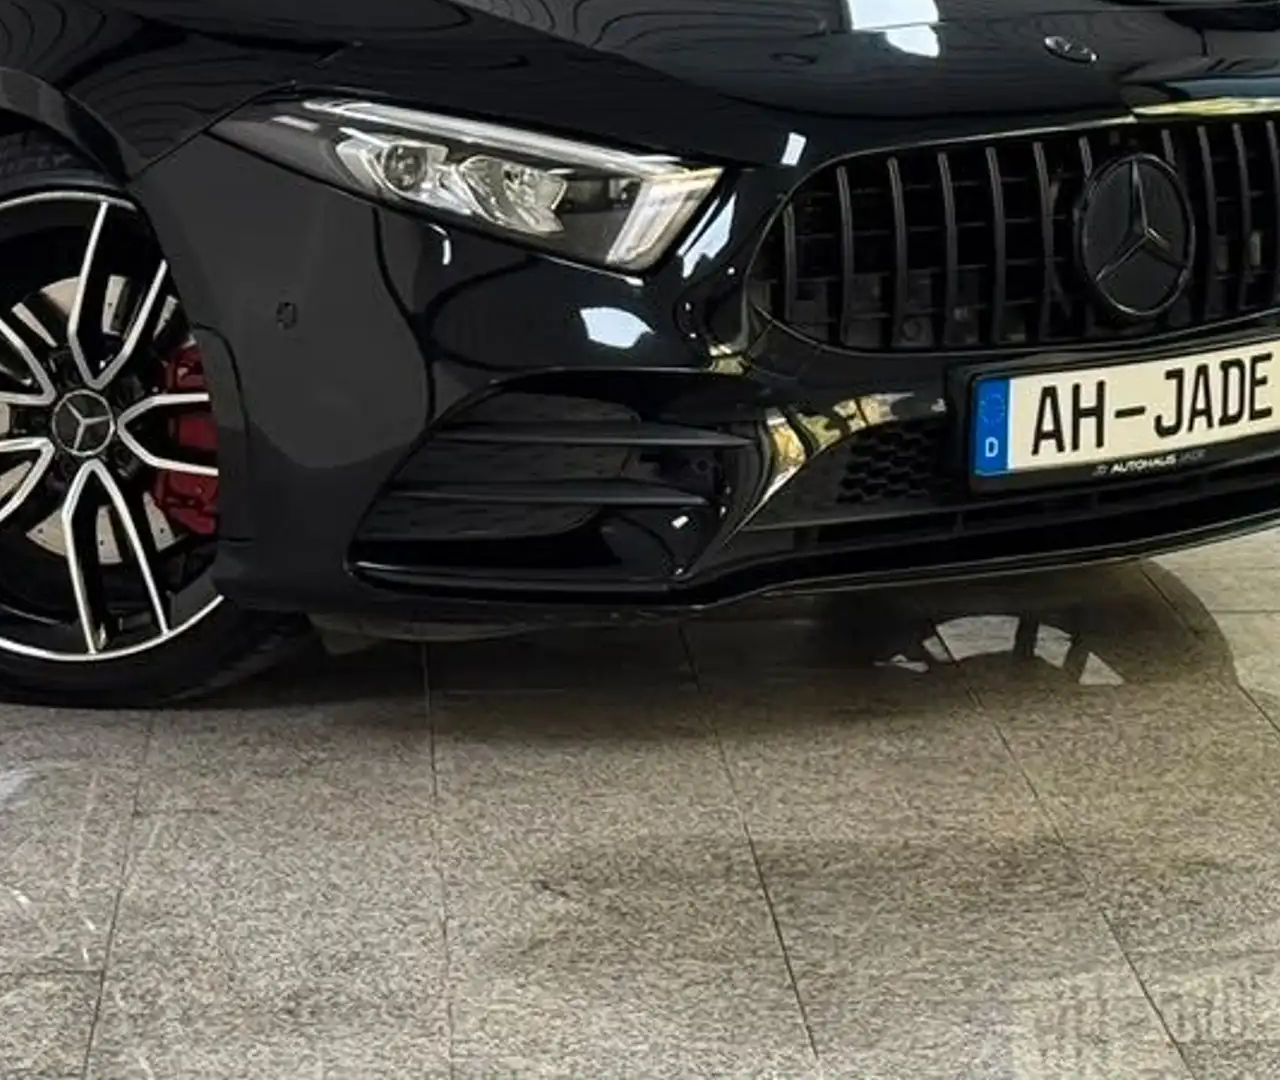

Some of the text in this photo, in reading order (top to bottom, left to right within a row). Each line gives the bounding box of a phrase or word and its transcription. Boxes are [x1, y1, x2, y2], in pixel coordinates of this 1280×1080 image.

[1031, 352, 1273, 457] AH-JADE
[984, 436, 999, 459] D
[1110, 453, 1177, 475] AUTOHAUS
